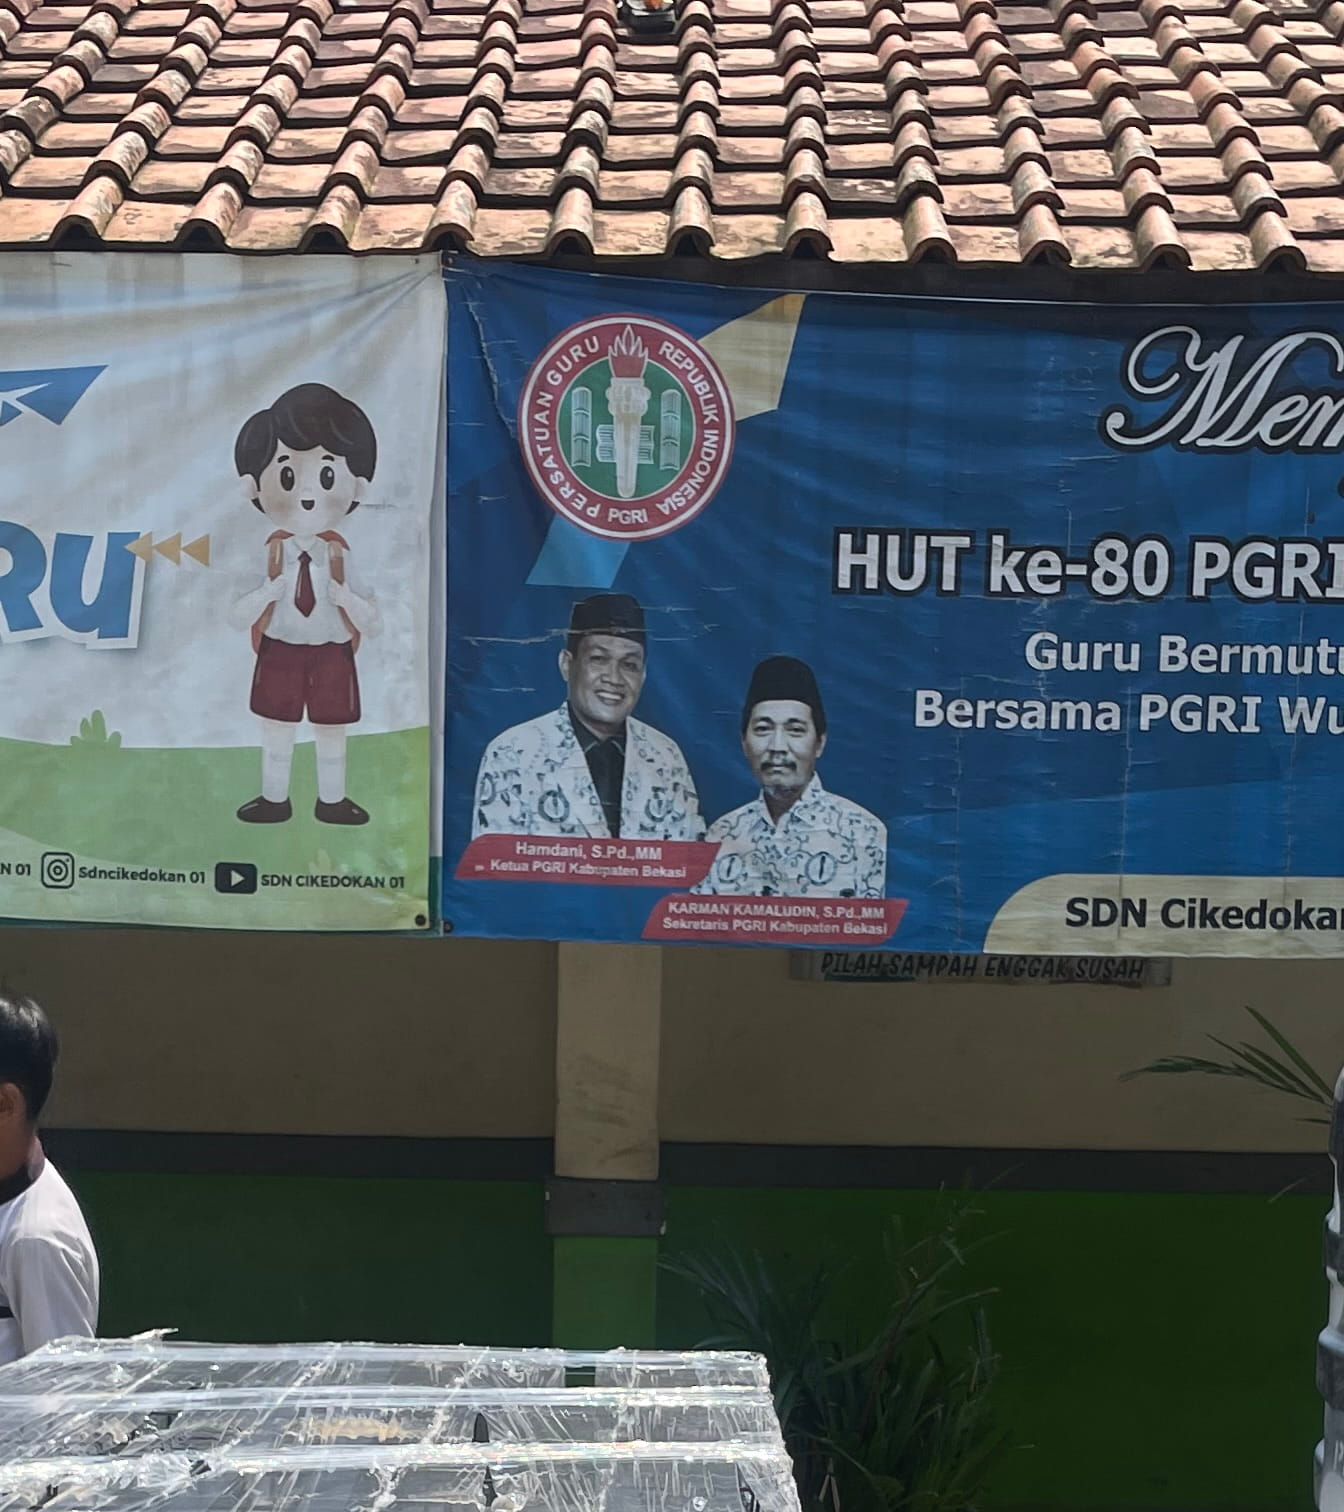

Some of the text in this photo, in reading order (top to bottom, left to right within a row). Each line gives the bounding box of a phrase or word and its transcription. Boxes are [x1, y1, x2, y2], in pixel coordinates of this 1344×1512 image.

[534, 335, 719, 518] PERSATUAN GURU REPUBLIK INDONESIA
[608, 508, 648, 524] PGRI
[837, 532, 971, 592] HUT
[989, 535, 1170, 597] ke-80
[1025, 631, 1140, 673] Guru
[914, 689, 1121, 731] Bersama
[1138, 693, 1262, 734] PGRI
[516, 841, 587, 860] Hamdani,
[16, 863, 31, 876] 01
[79, 866, 206, 884] Sdncikedokan 01
[490, 859, 687, 879] Ketua PGRI Kabupaten Bekasi
[261, 874, 405, 889] SDN CIKEDOKAN 01
[668, 902, 729, 915] KARMAN
[733, 903, 820, 919] KAMALUDIN,
[1064, 896, 1147, 929] SDN
[662, 918, 887, 936] Sekretaris PGRI Kabupaten Bekasi
[820, 952, 1145, 980] PILAH SAMPAH ENGGAK SUSAH
